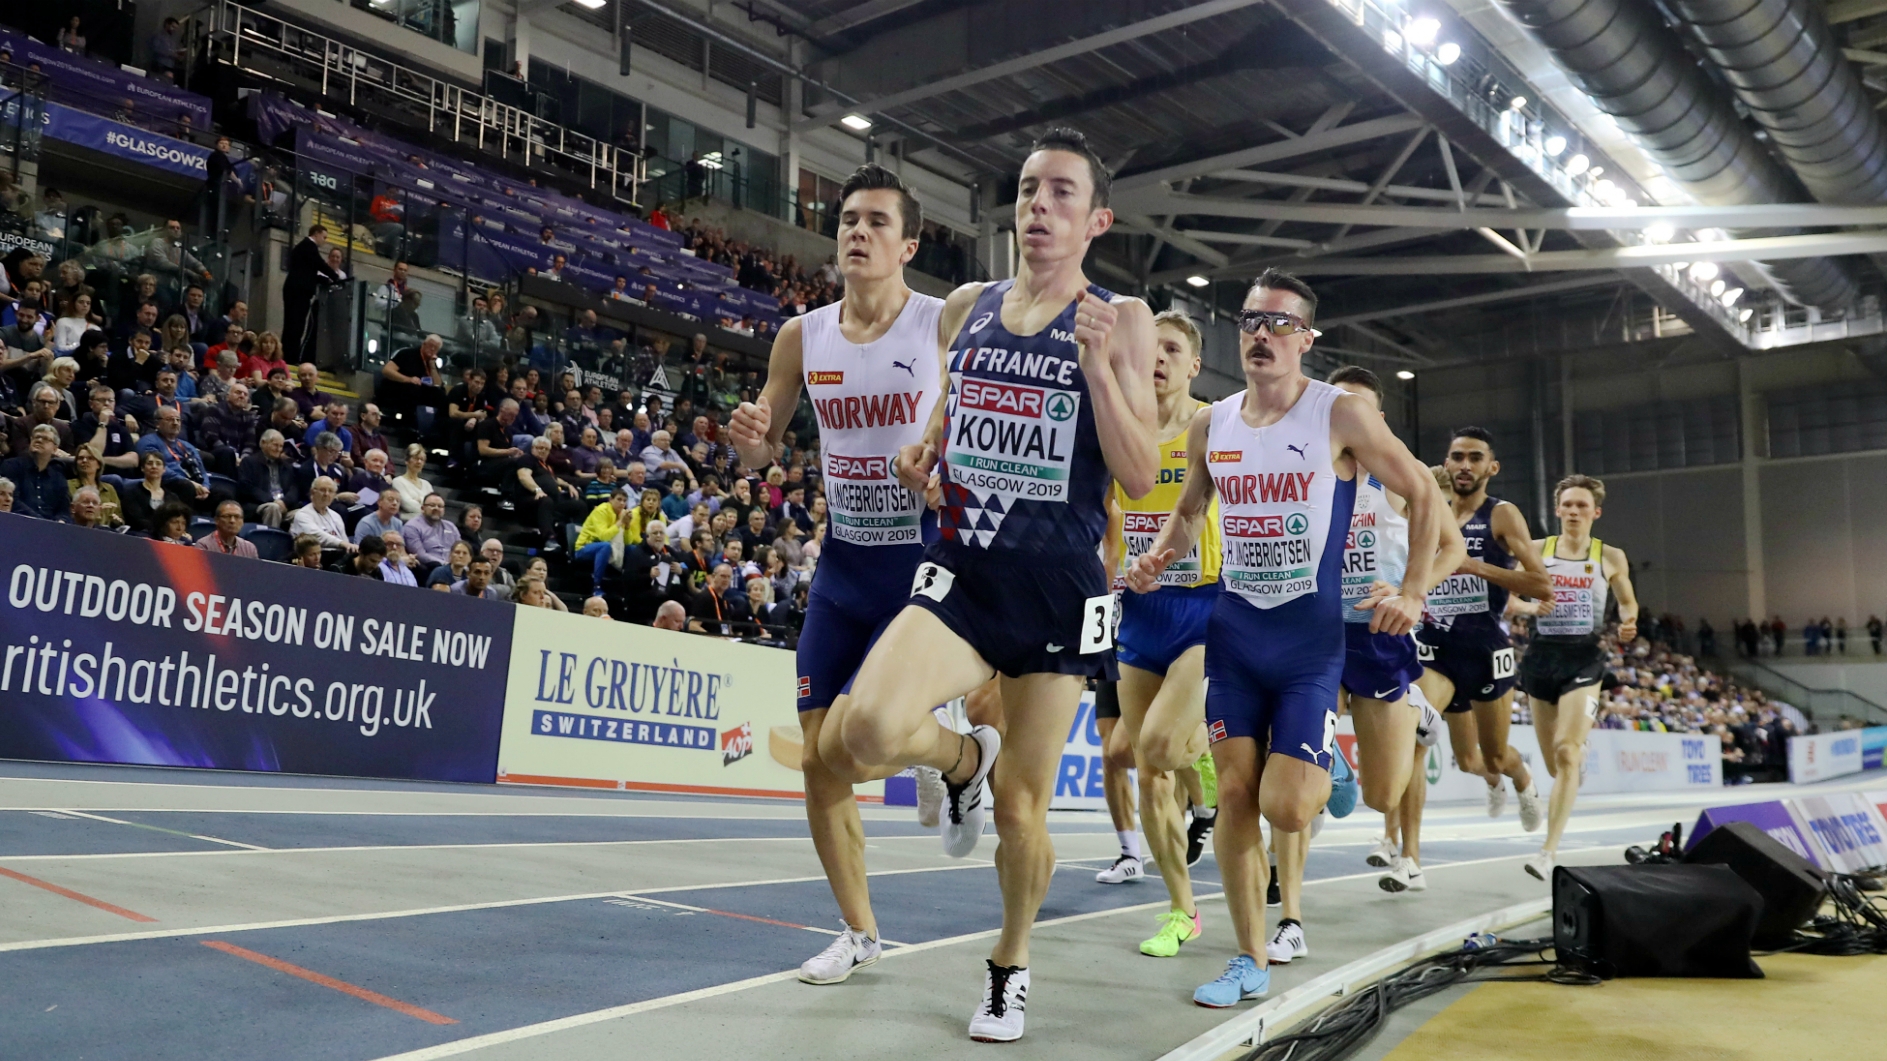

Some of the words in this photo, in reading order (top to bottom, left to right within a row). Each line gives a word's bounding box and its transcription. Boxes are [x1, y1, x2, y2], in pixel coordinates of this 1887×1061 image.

[137, 87, 172, 103] EUROPEAN
[173, 98, 208, 114] ATHLETICS
[1050, 328, 1078, 344] MA
[971, 347, 1078, 386] FRANCE
[584, 370, 619, 385] EUROPEAN
[584, 378, 619, 391] ATHLETICS
[819, 374, 842, 382] EXTRA
[962, 383, 1041, 414] SPAR
[814, 390, 923, 430] NORWAY
[956, 413, 1066, 462] KOWAL
[828, 456, 886, 477] SPAR
[975, 458, 998, 470] RUN
[1000, 462, 1038, 476] CLEAN
[1220, 453, 1241, 461] EXTRA
[952, 468, 1025, 494] GLASGOW
[1027, 482, 1062, 496] 2019
[1214, 471, 1315, 505] NORWAY
[835, 481, 917, 513] INGEBRIGTSEN
[846, 516, 860, 526] RUN
[862, 518, 894, 527] CLEAN
[1224, 516, 1283, 535] SPAR
[1352, 512, 1376, 527] TAIN
[1465, 523, 1487, 531] MAIF
[835, 526, 885, 542] GLASGOW
[887, 528, 917, 541] 2019
[1466, 537, 1484, 550] CE
[1235, 538, 1311, 567] INGEBRIGTSEN
[1341, 551, 1376, 574] ARE
[1174, 573, 1197, 583] 2019
[1243, 571, 1260, 580] RUN
[1262, 571, 1292, 580] CLEAN
[1341, 577, 1362, 585] LEAN
[1550, 574, 1594, 589] ERMANY
[1230, 580, 1283, 595] GLASGOW
[1286, 579, 1312, 593] 2019
[9, 564, 176, 629] OUTDOOR
[183, 591, 307, 646] SEASON
[314, 611, 353, 651] ON
[360, 618, 427, 661] SALE
[431, 630, 492, 669] NOW
[1430, 605, 1467, 615] GLASGOW
[1093, 605, 1106, 645] 3
[1494, 653, 1513, 674] 10
[1, 636, 437, 737] ritishathletics.org.uk
[535, 649, 577, 704] LE
[585, 657, 721, 720] GRUYÈRE
[541, 714, 710, 747] SWITZERLAND
[1681, 739, 1705, 760] TOYO
[1055, 754, 1105, 797] RE
[1687, 764, 1712, 784] TIRES
[1809, 815, 1855, 855] TOYO
